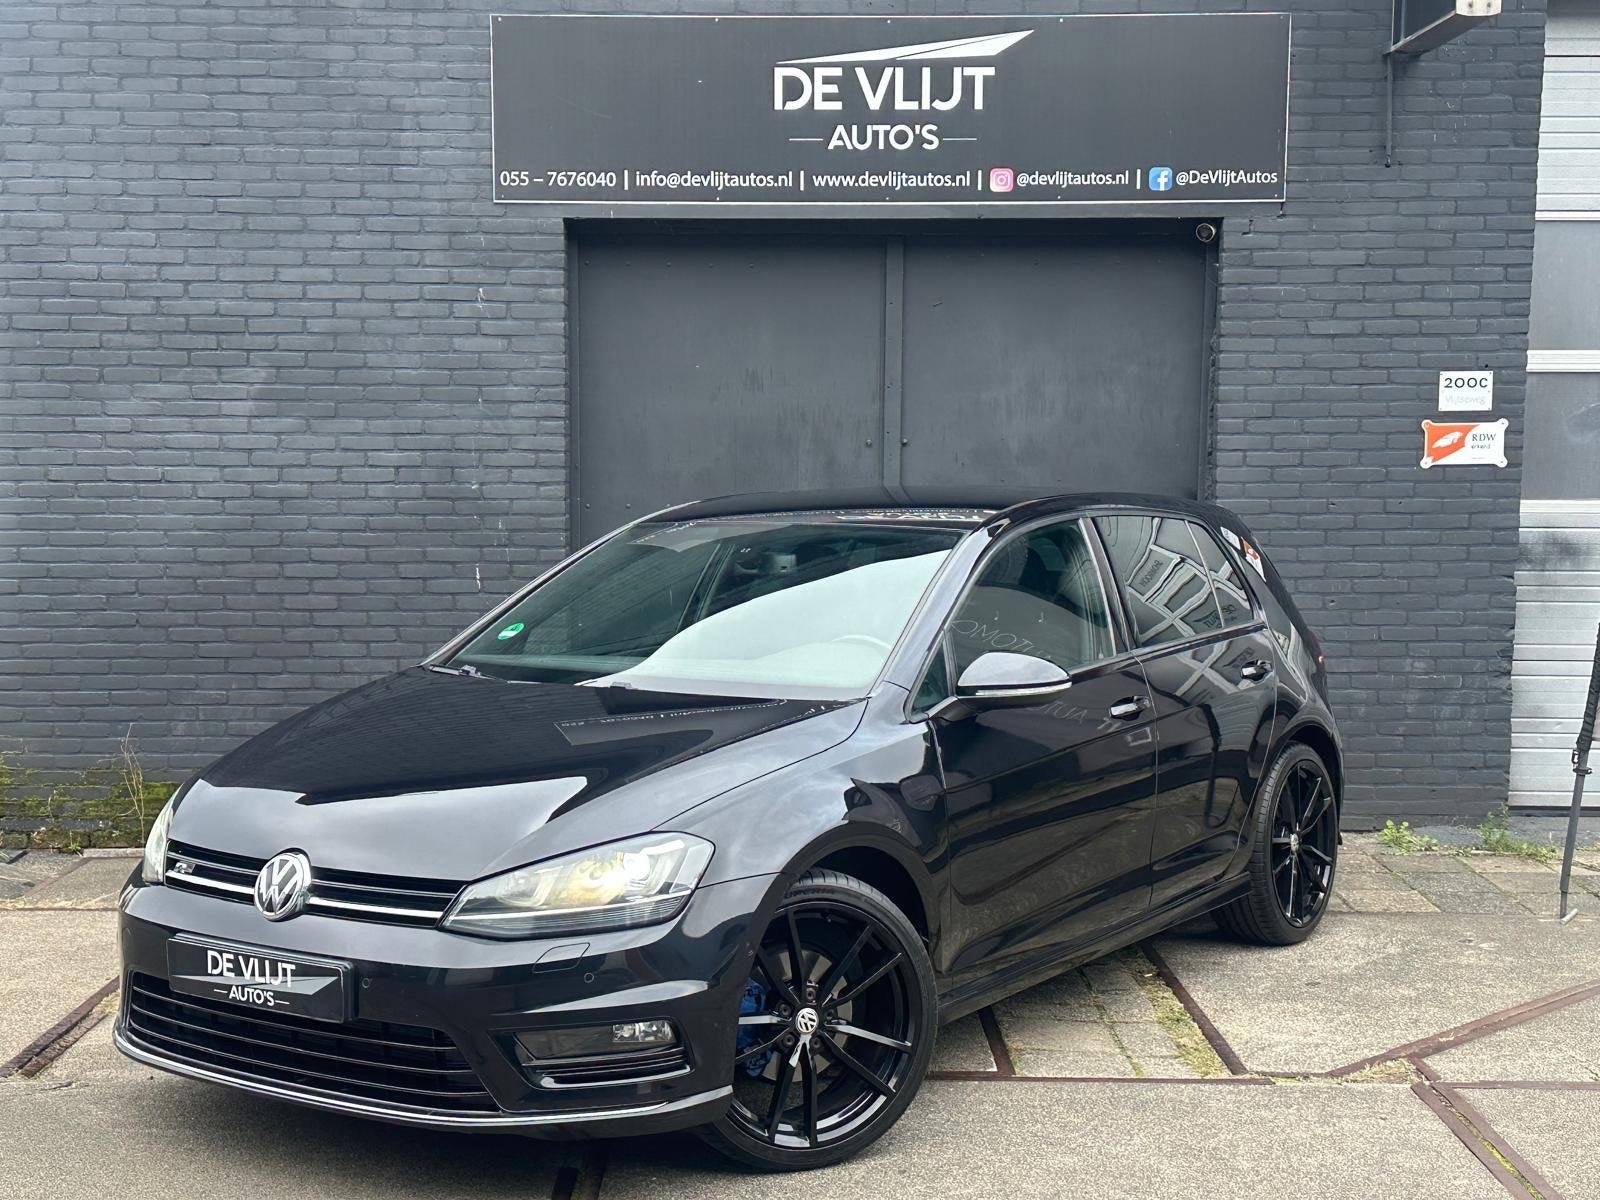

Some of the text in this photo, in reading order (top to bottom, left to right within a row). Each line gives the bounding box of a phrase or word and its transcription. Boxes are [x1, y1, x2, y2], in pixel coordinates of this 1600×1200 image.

[774, 66, 996, 111] DE VLIJT
[827, 124, 940, 151] AUTO'S
[499, 171, 530, 187] 055
[547, 171, 617, 187] 7676040
[635, 170, 793, 191] info@devlijtautos.nl
[812, 170, 971, 191] www.devlijtautos.nl
[1016, 169, 1129, 189] @devlijtautos.nl
[1175, 169, 1278, 187] @DeVlijtAutos
[1444, 377, 1488, 389] 200C
[1471, 433, 1497, 442] RDW
[207, 950, 296, 988] DE VLIJT
[229, 985, 275, 1007] AUTO'S
